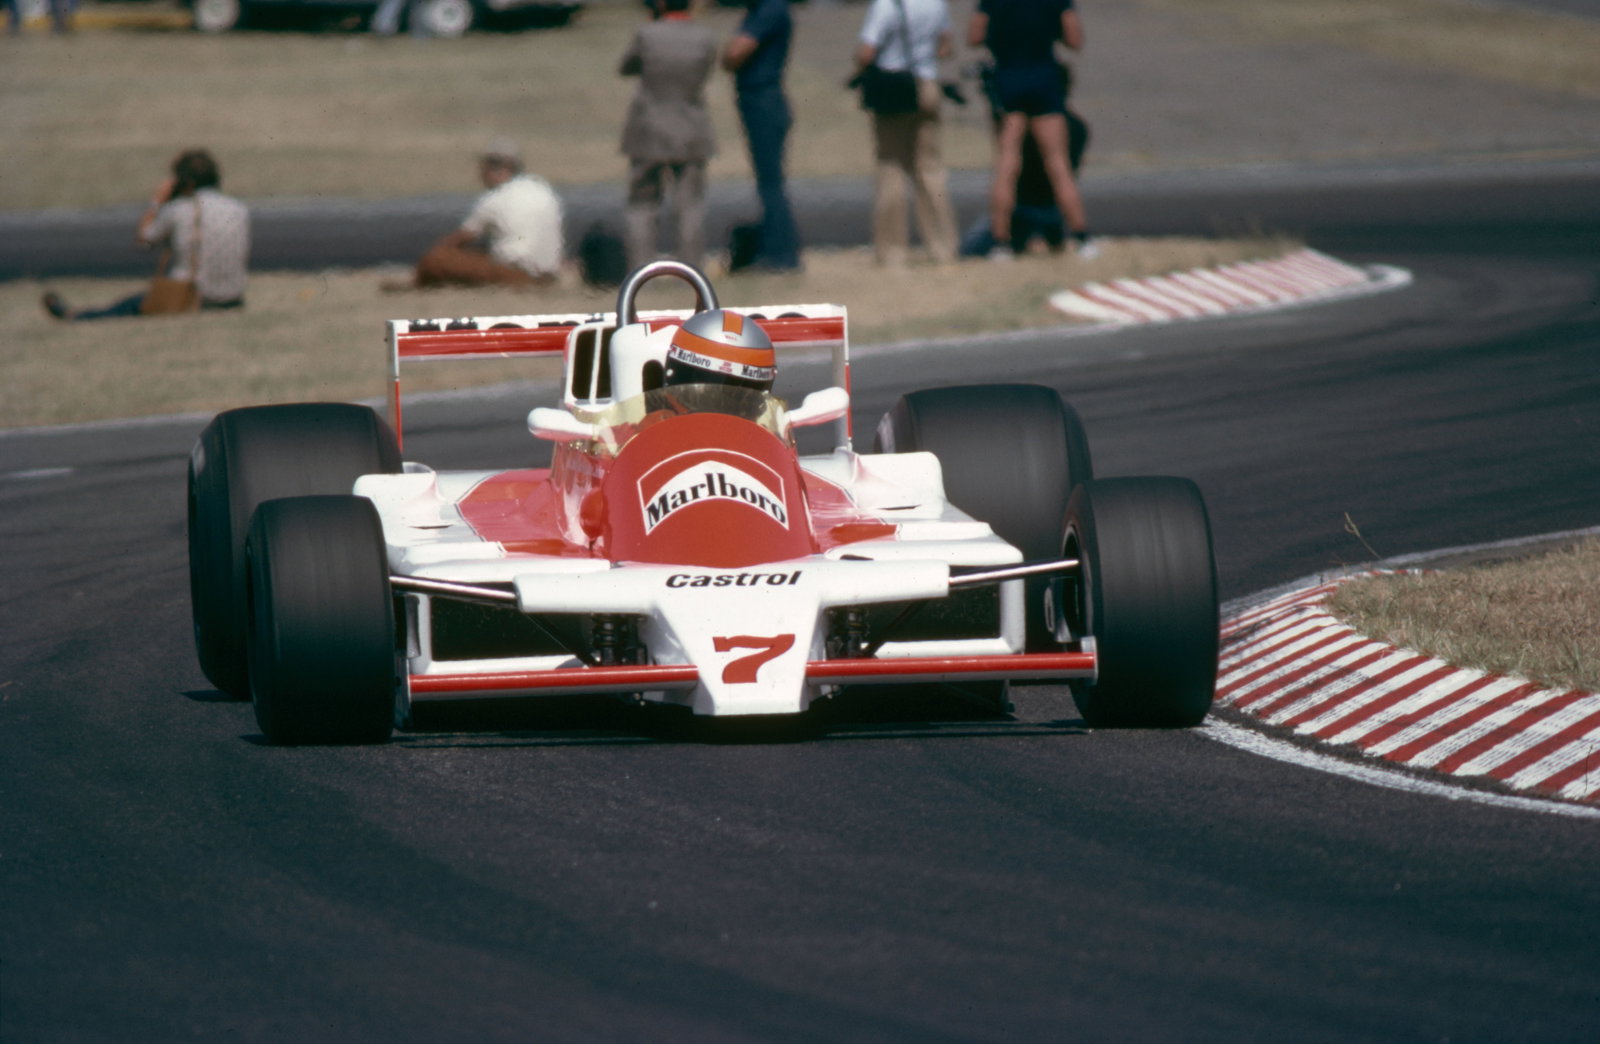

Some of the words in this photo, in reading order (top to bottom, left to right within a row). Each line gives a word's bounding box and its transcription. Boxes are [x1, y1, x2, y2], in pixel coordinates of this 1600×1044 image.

[677, 349, 711, 368] Marlboro
[646, 472, 787, 528] Marlboro
[665, 571, 803, 588] Castrol
[712, 633, 796, 684] 7
